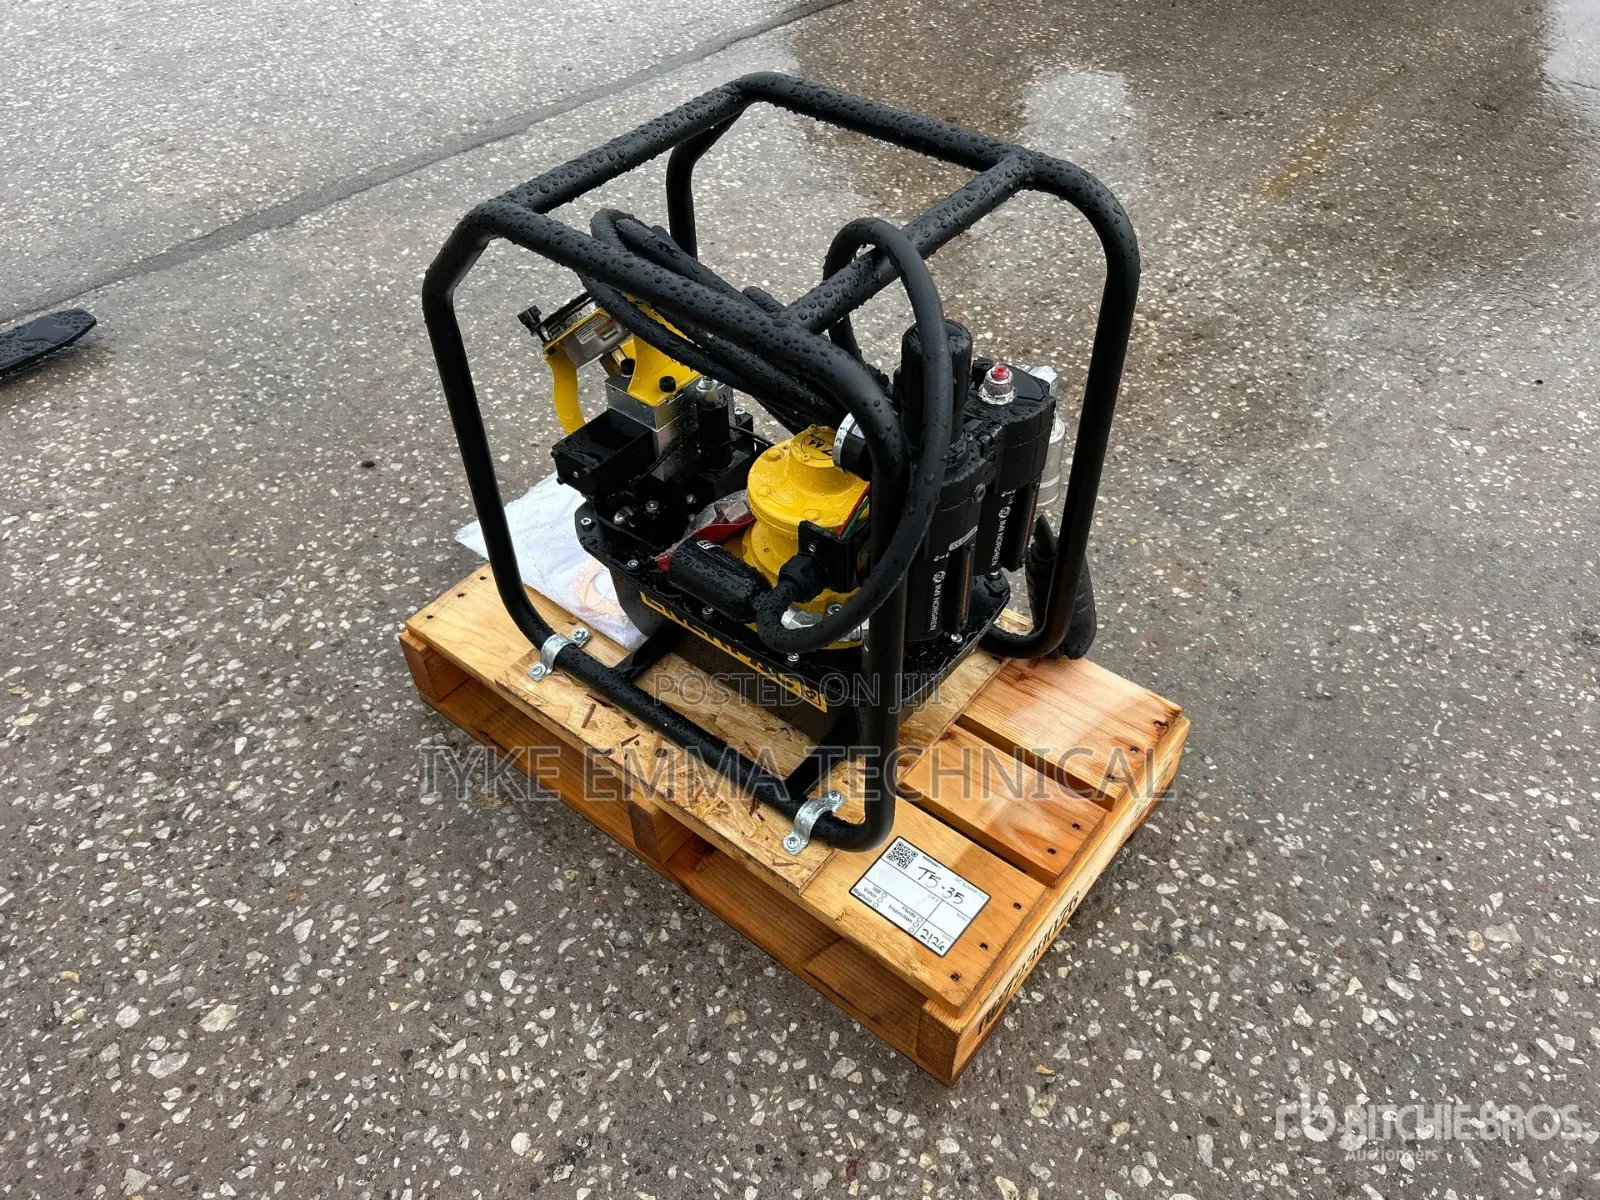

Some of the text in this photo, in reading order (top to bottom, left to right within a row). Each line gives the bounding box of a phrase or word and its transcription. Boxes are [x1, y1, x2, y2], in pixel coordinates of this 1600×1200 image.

[991, 532, 1004, 566] NORGREN
[930, 597, 940, 631] NORGREN
[863, 886, 877, 898] Video
[888, 904, 913, 924] Inspection
